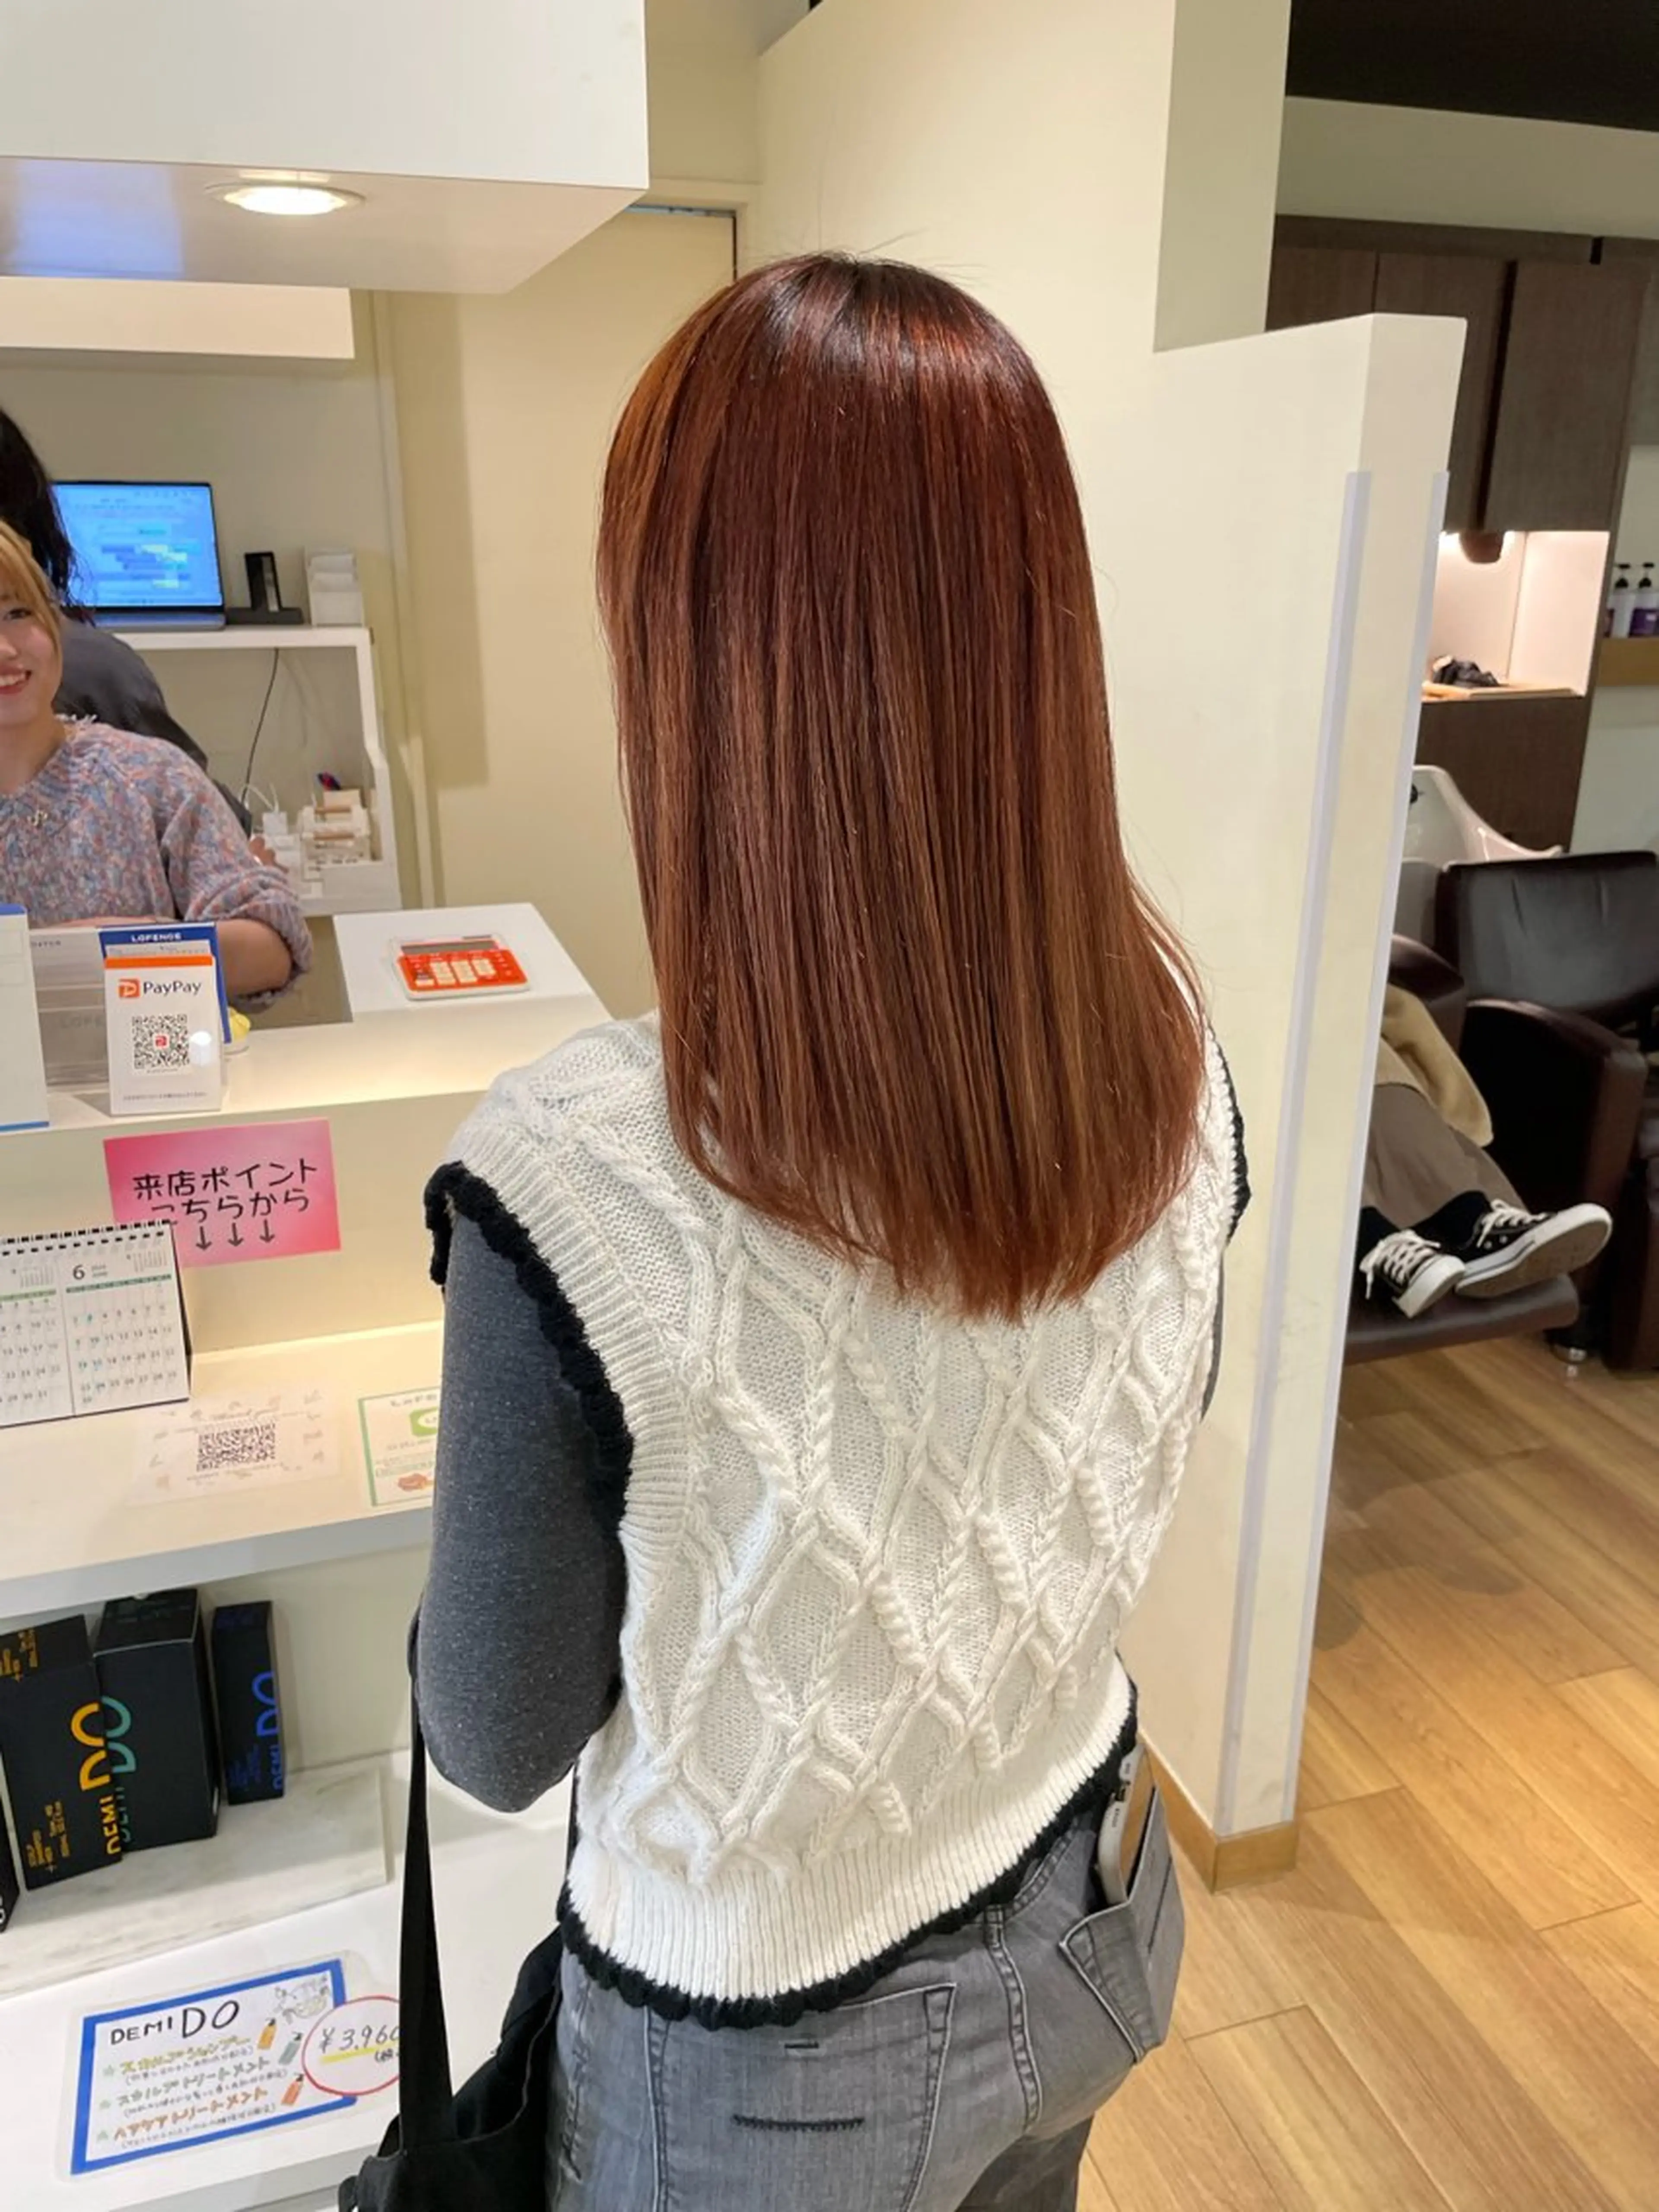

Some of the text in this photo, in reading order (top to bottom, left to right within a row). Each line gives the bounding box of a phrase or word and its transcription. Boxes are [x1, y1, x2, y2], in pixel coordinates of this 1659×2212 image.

[143, 979, 202, 996] PayPay
[133, 1158, 318, 1200] 来店ポイント
[73, 1264, 85, 1280] 6
[110, 2000, 240, 2045] DEMI DO
